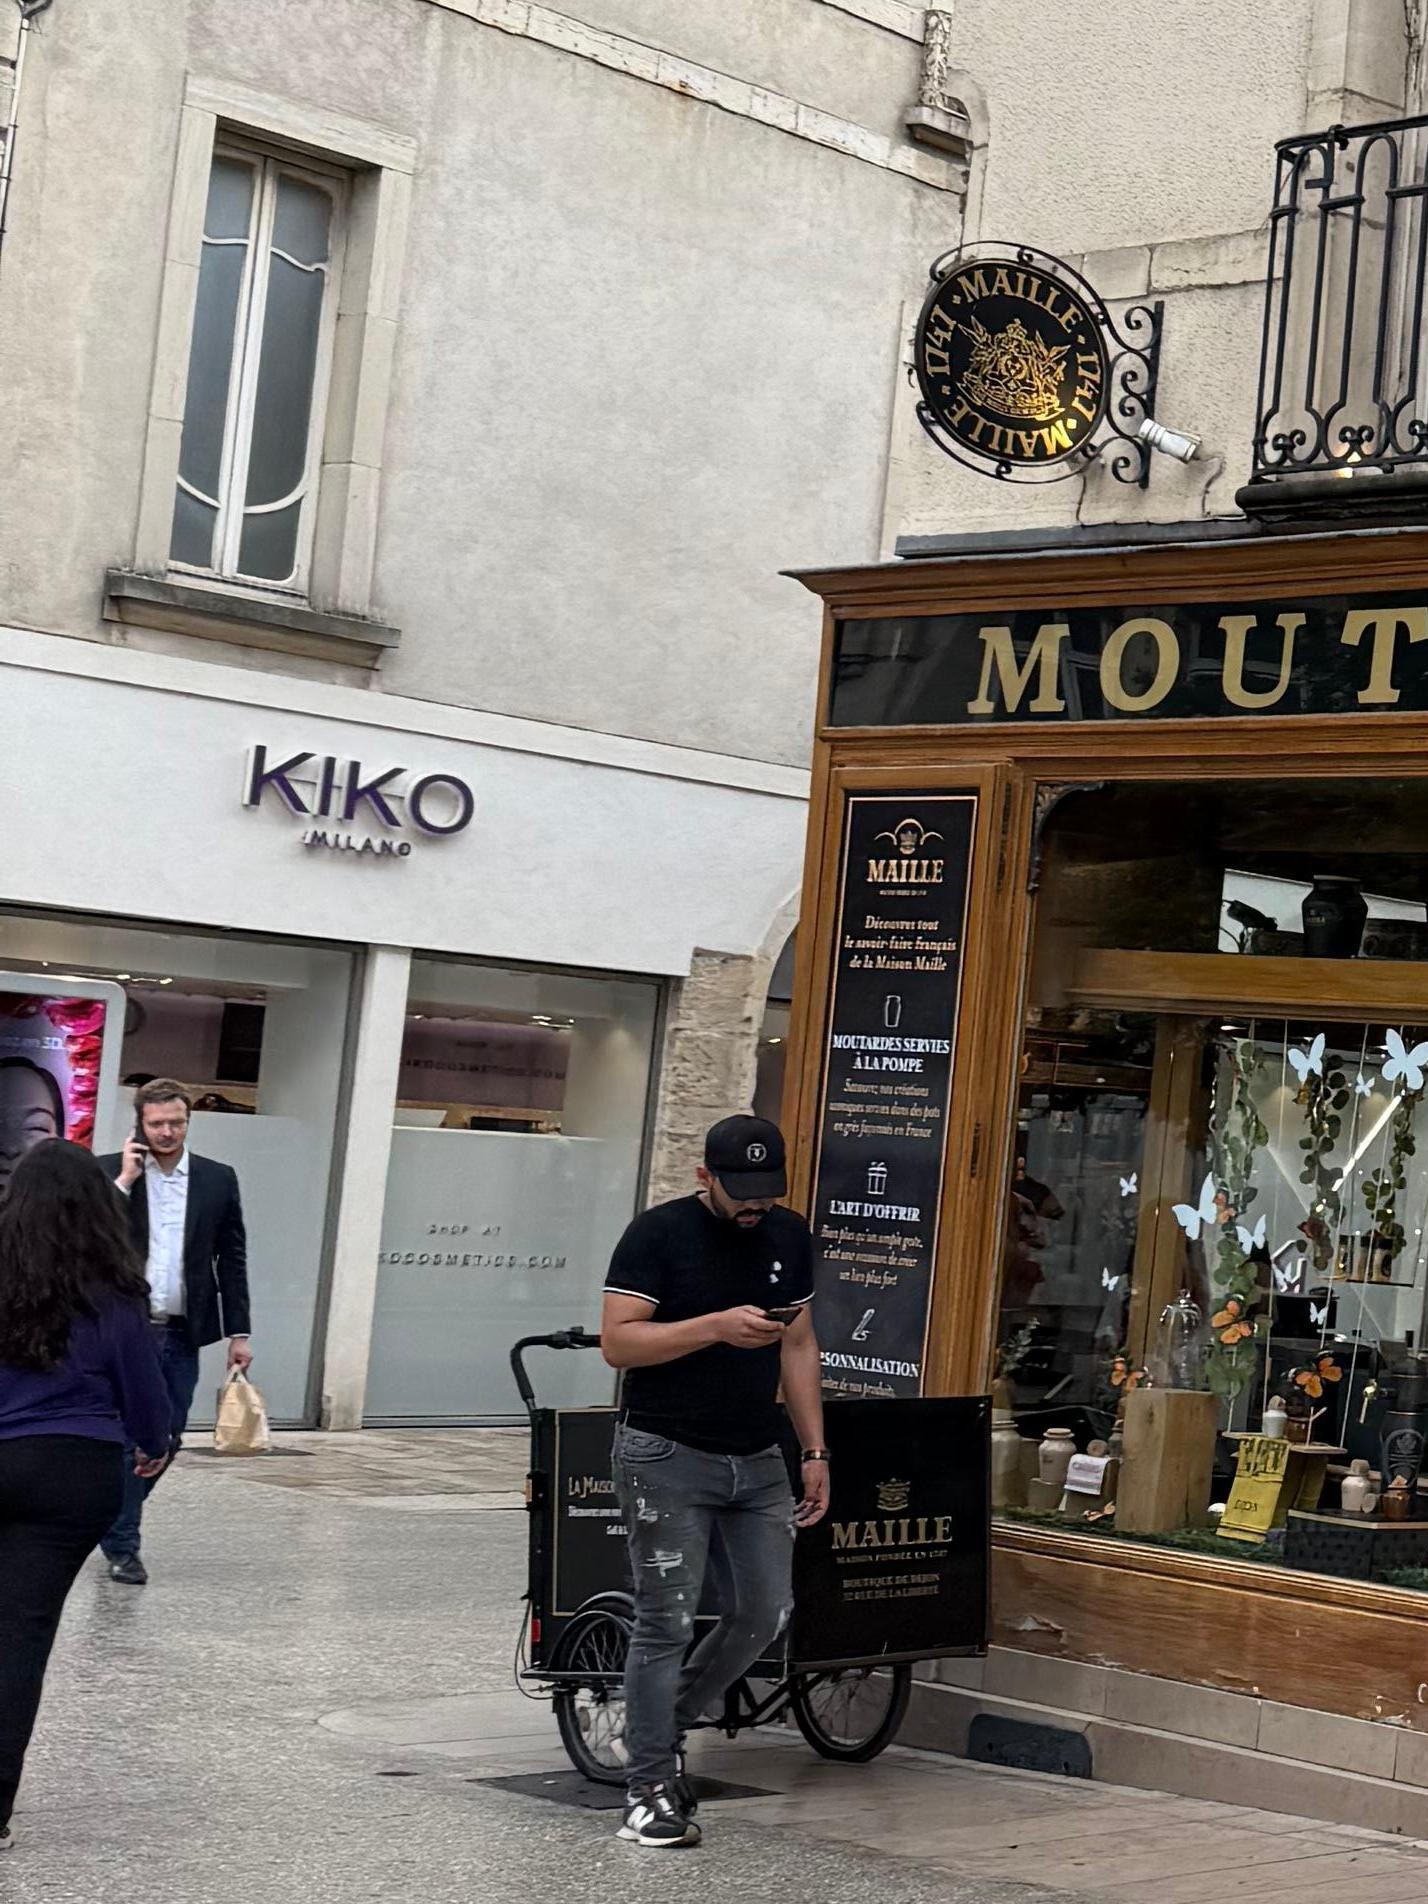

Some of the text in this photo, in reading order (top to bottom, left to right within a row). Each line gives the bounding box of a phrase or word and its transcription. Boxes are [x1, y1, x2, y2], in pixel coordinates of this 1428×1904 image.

[957, 268, 1083, 333] MAILLE
[924, 304, 957, 379] 1747
[1072, 351, 1101, 423] 1747
[943, 395, 1074, 458] MAILLE
[245, 745, 475, 835] KIKO
[302, 829, 412, 857] MILANO
[866, 859, 945, 883] MAILLE
[875, 955, 912, 970] Maison
[914, 956, 948, 971] Maille
[832, 1034, 950, 1054] MOUTARDES SERVIES
[863, 1055, 880, 1070] LA
[882, 1056, 924, 1073] POMPE
[830, 1199, 921, 1222] L'ART D'OFFRIR
[831, 1516, 953, 1549] MAILLE
